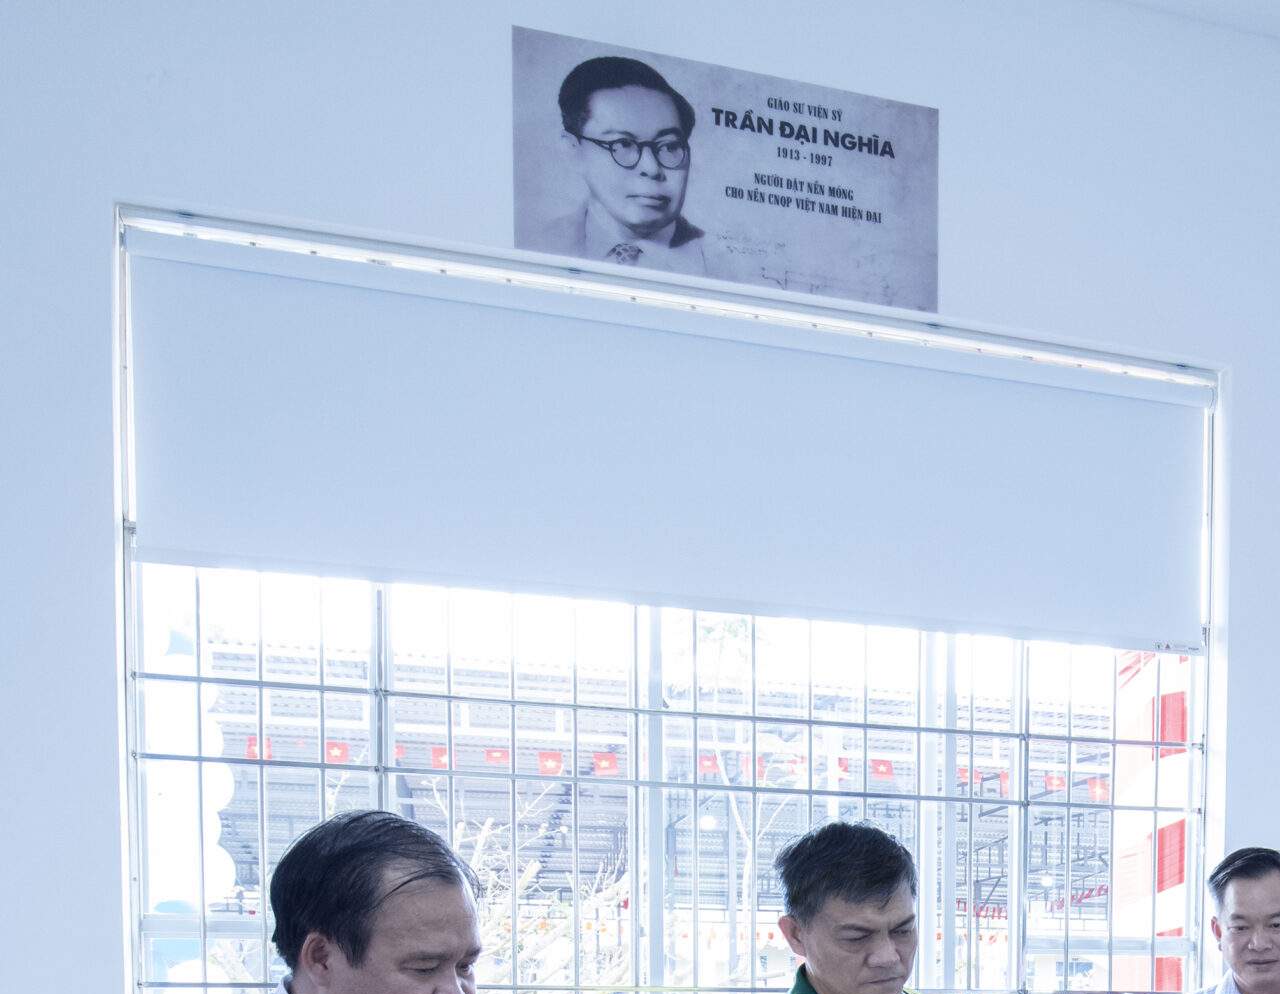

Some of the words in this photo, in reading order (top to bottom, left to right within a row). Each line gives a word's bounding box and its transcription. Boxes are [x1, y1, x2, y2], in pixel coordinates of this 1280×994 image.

[767, 97, 790, 112] GIÁO
[793, 102, 805, 115] SƯ
[808, 105, 828, 120] VIỆN
[712, 108, 774, 136] TRẦN
[779, 120, 817, 145] ĐẠI
[823, 129, 895, 159] NGHĨA
[776, 147, 800, 161] 1913
[810, 152, 833, 166] 1997
[754, 172, 783, 188] NGƯỜI
[786, 177, 805, 192] ĐẶT
[807, 181, 825, 196] NỀN
[828, 184, 854, 201] MÓNG
[725, 186, 744, 200] CHO
[747, 188, 766, 204] NỀN
[768, 193, 792, 208] CNQP
[795, 198, 816, 214] VIỆT
[819, 203, 838, 217] NAM
[841, 206, 863, 221] HIỆN
[866, 211, 882, 224] ĐẠI
